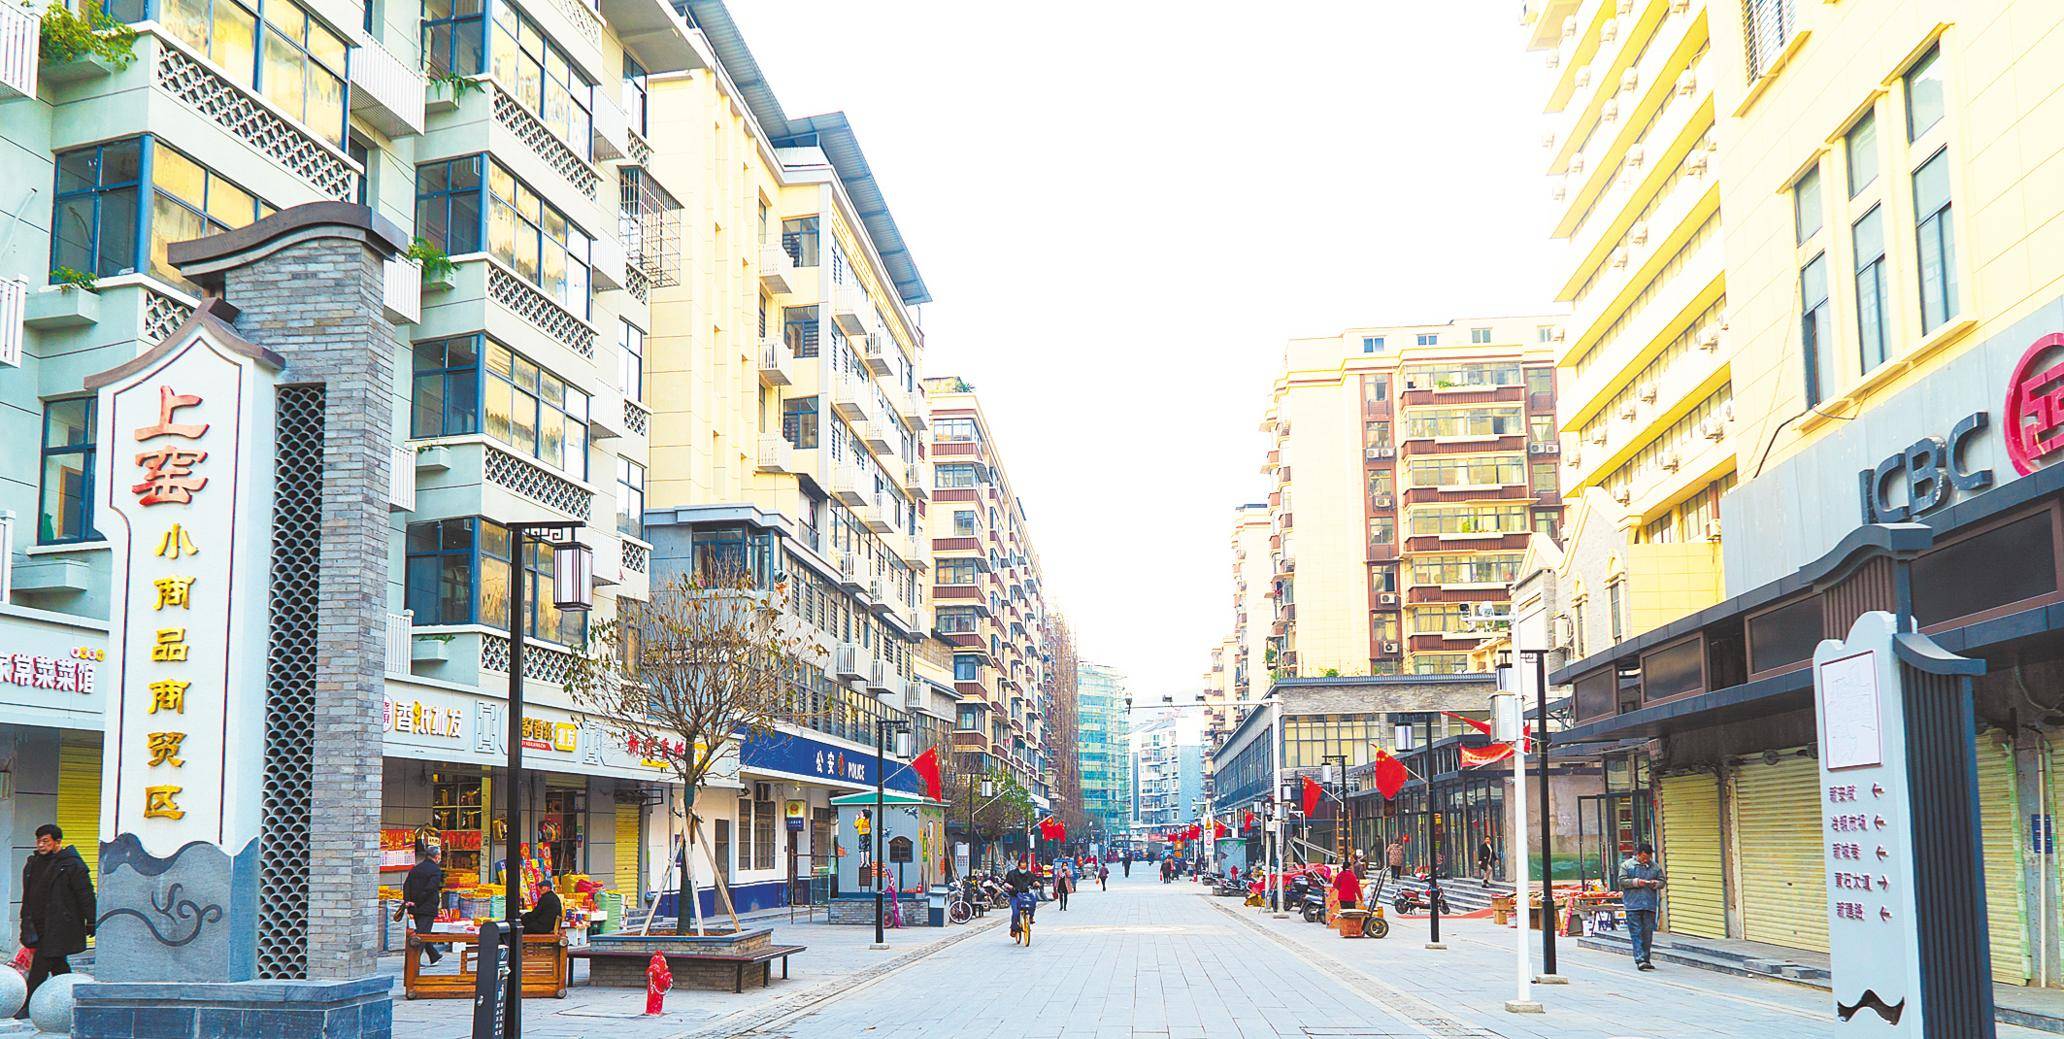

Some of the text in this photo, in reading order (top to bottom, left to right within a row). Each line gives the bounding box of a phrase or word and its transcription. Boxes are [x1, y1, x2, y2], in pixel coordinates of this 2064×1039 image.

[131, 385, 210, 507] 上窑
[1859, 411, 1994, 525] ICBC
[143, 523, 200, 821] 小商品商贸区
[815, 750, 865, 781] 公安 POLICE
[1834, 872, 1873, 892] 黄石大道
